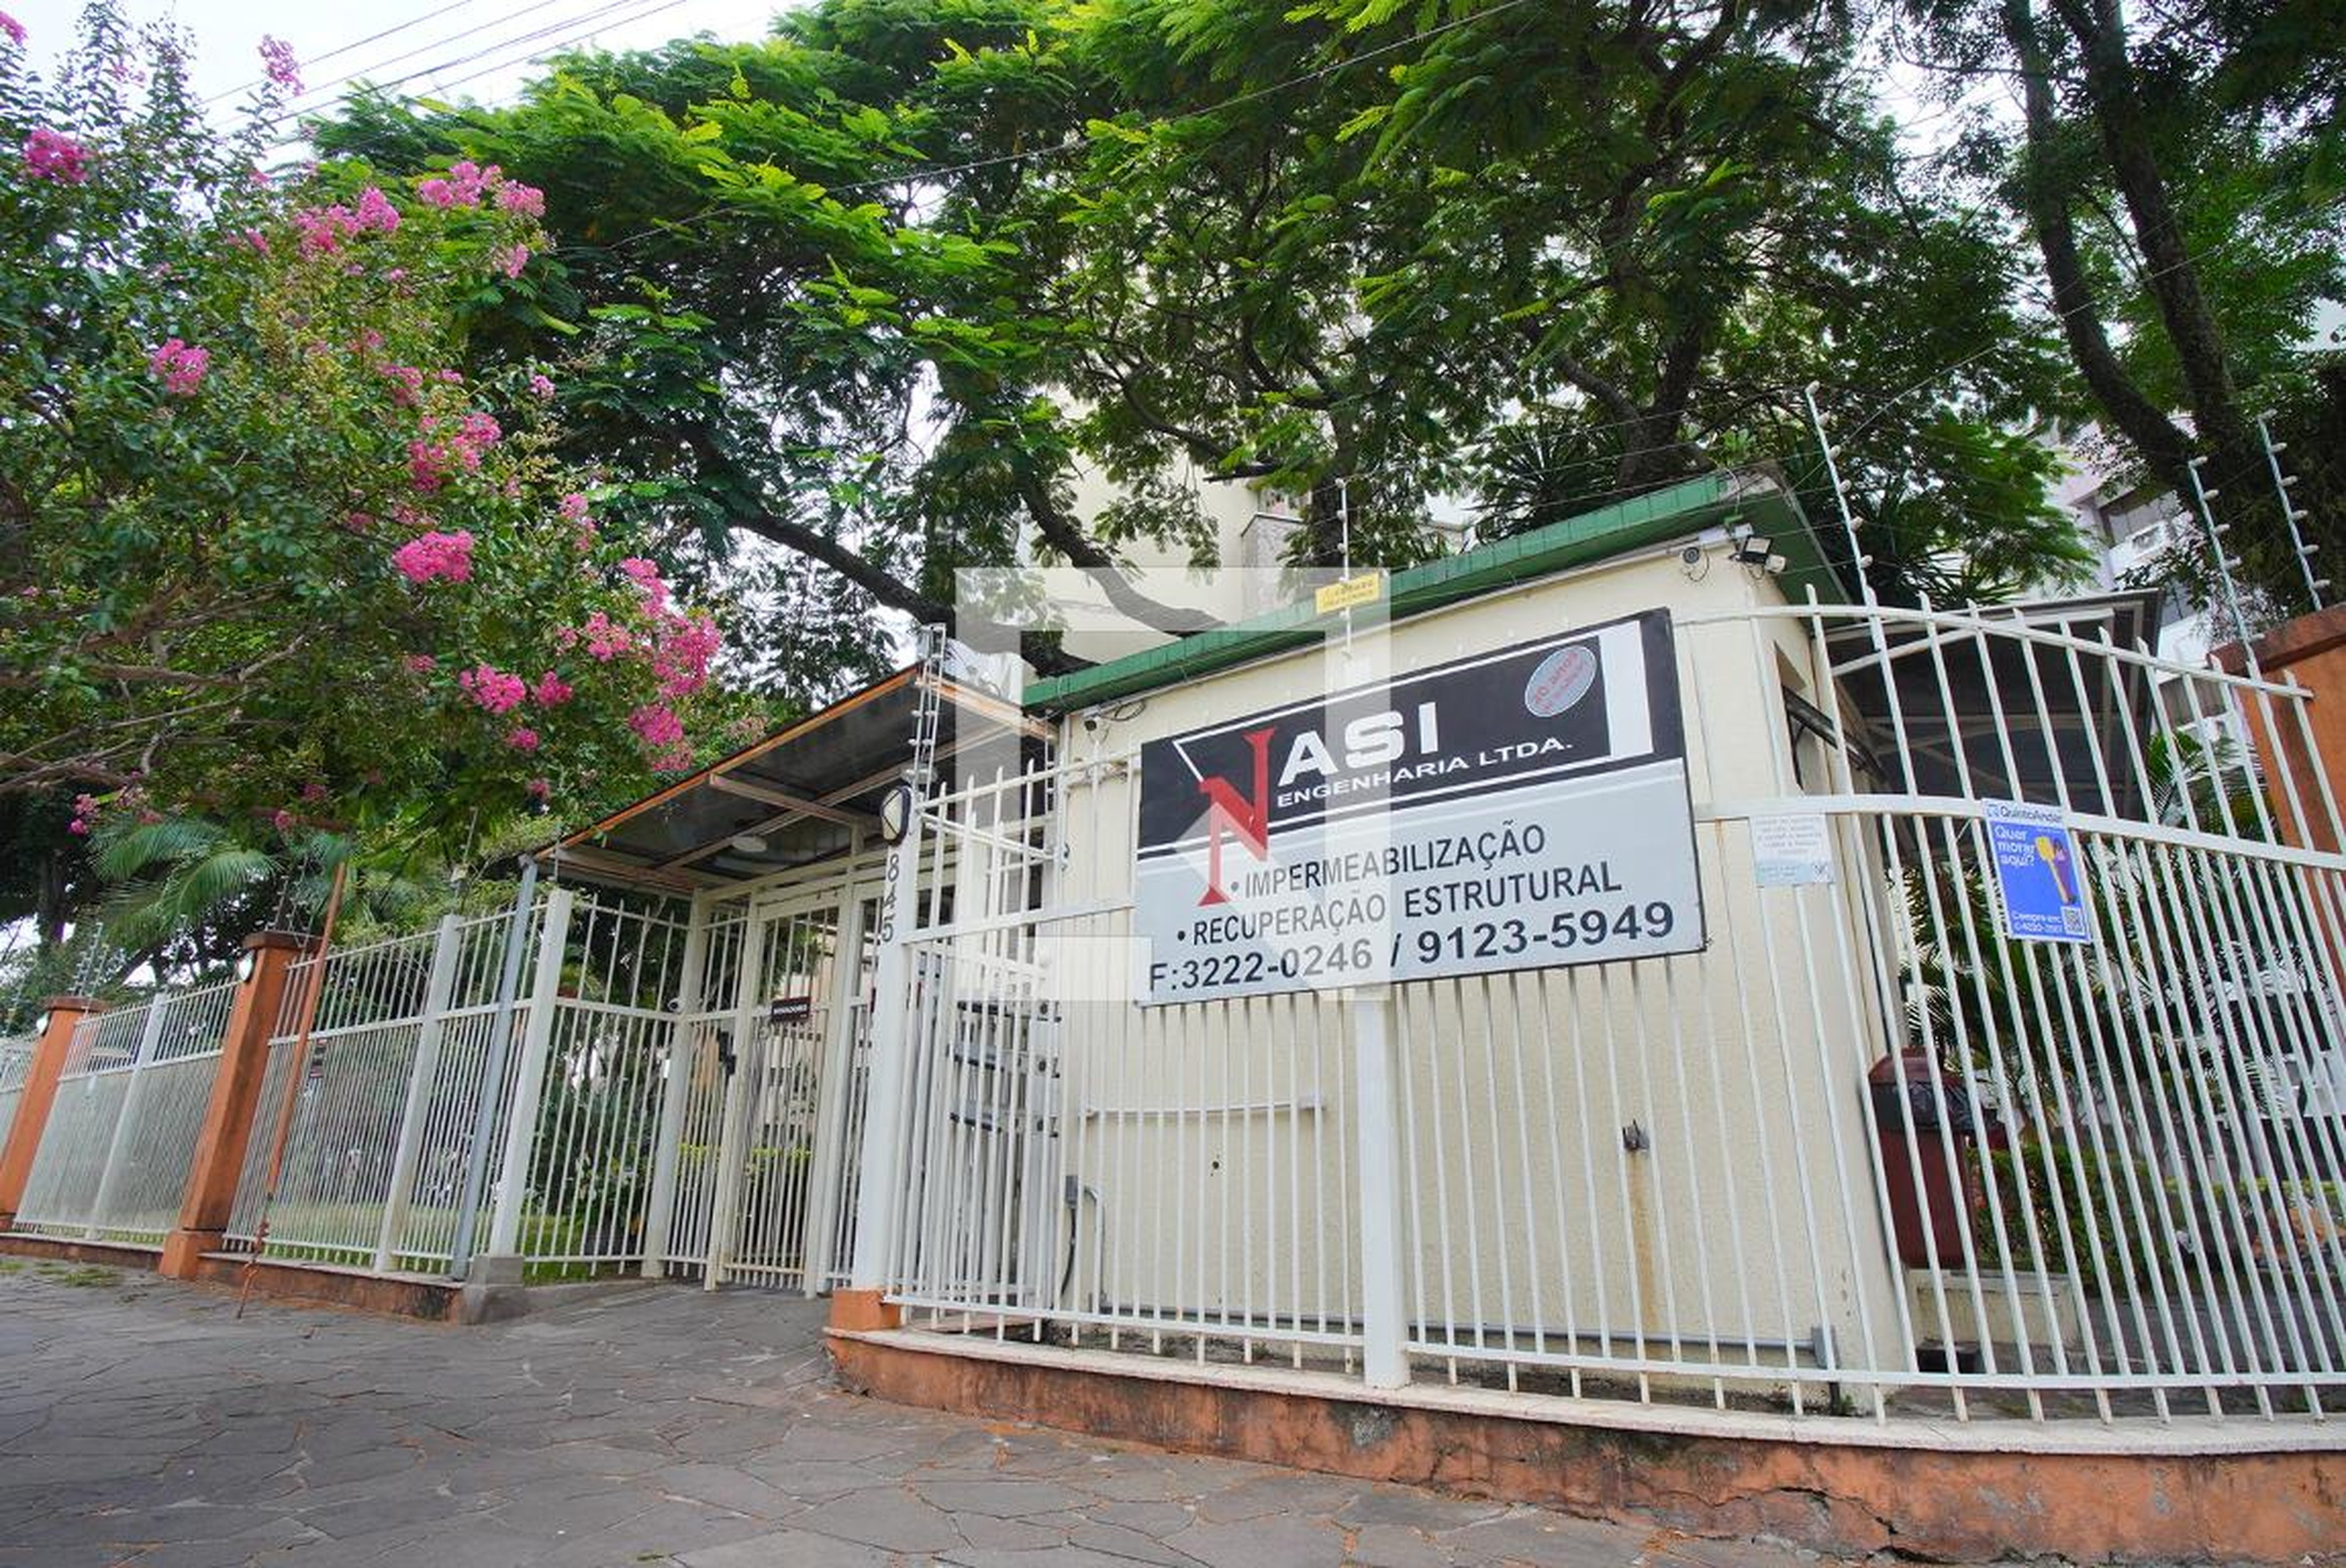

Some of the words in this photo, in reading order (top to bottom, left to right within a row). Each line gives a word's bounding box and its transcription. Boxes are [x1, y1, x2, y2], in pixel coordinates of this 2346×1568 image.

[1277, 756, 1469, 808] ENGENHARIA
[1479, 737, 1573, 767] LTDA.
[1245, 819, 1546, 898] IMPERMEABILIZAÇÃO
[1193, 888, 1386, 945] RECUPERAÇÃO
[1405, 861, 1622, 917] ESTRUTURAL
[1417, 901, 1675, 964] 9123-5949
